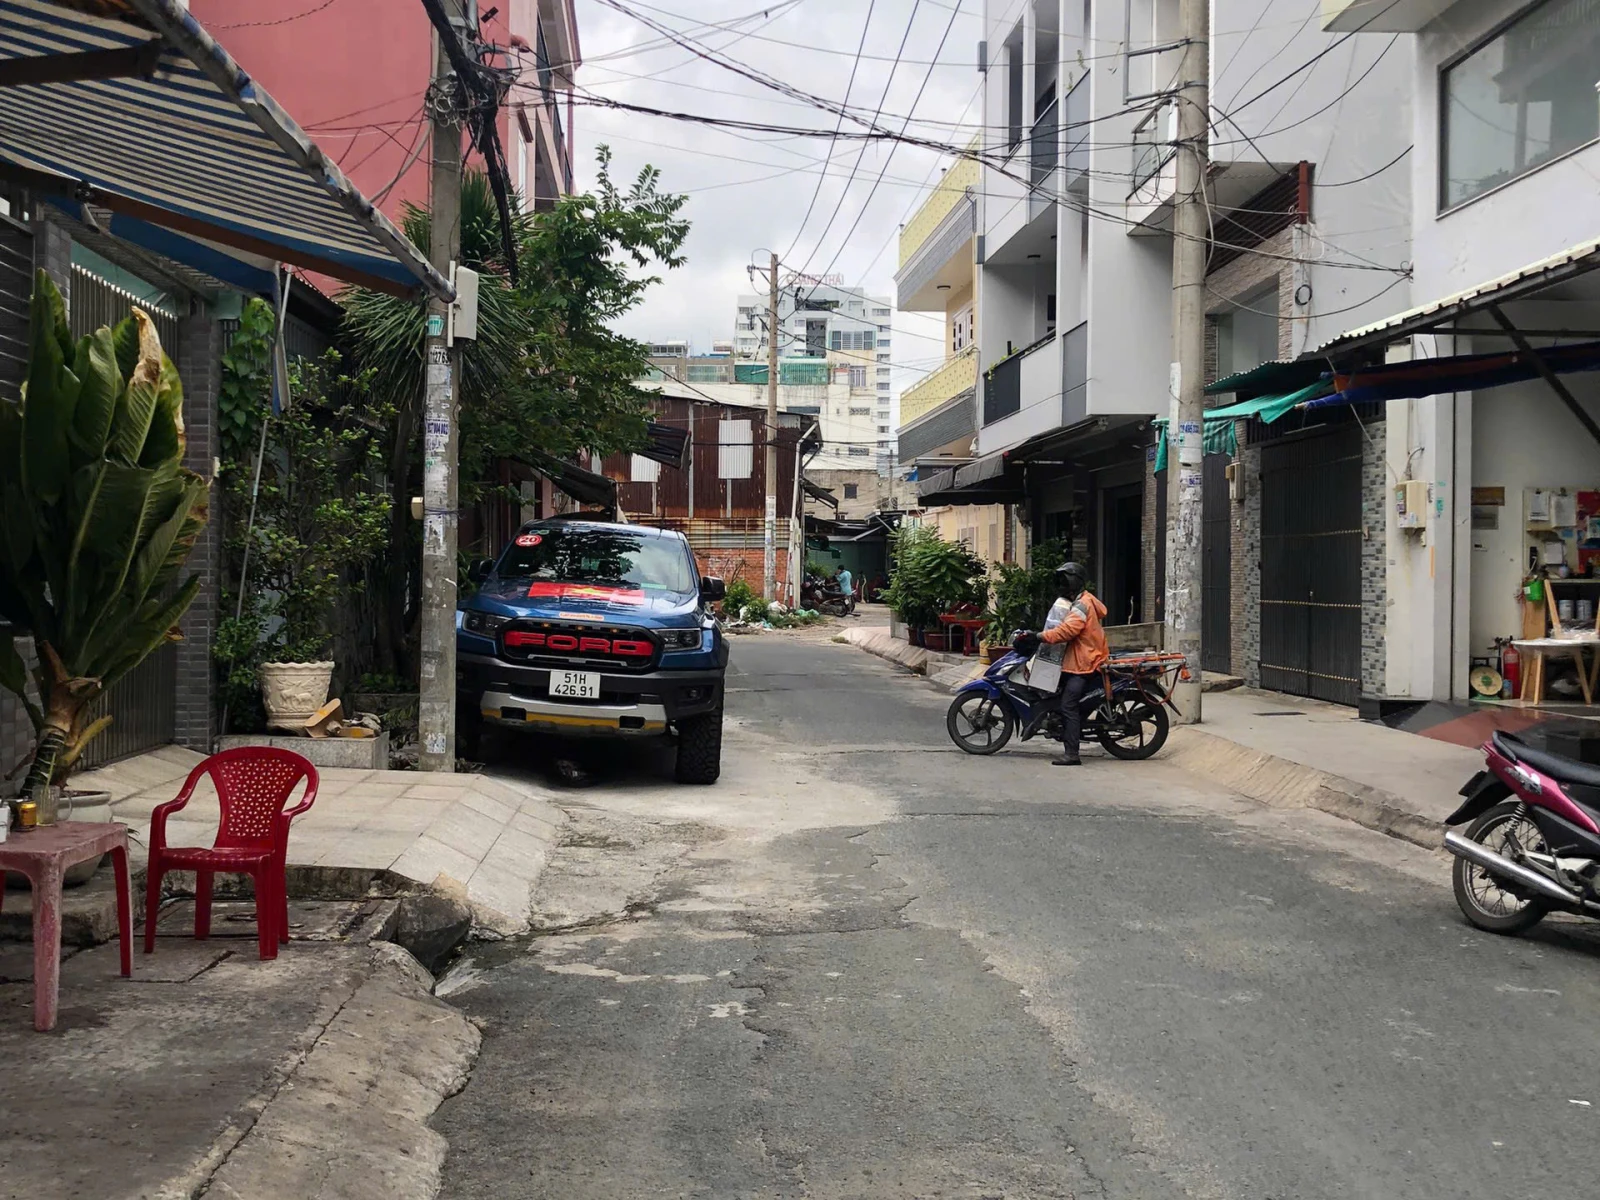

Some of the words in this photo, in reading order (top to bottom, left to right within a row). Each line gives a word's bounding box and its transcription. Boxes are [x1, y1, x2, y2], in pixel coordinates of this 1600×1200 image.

[505, 630, 653, 656] FORD
[564, 673, 587, 685] 51H
[554, 684, 594, 697] 426.91
